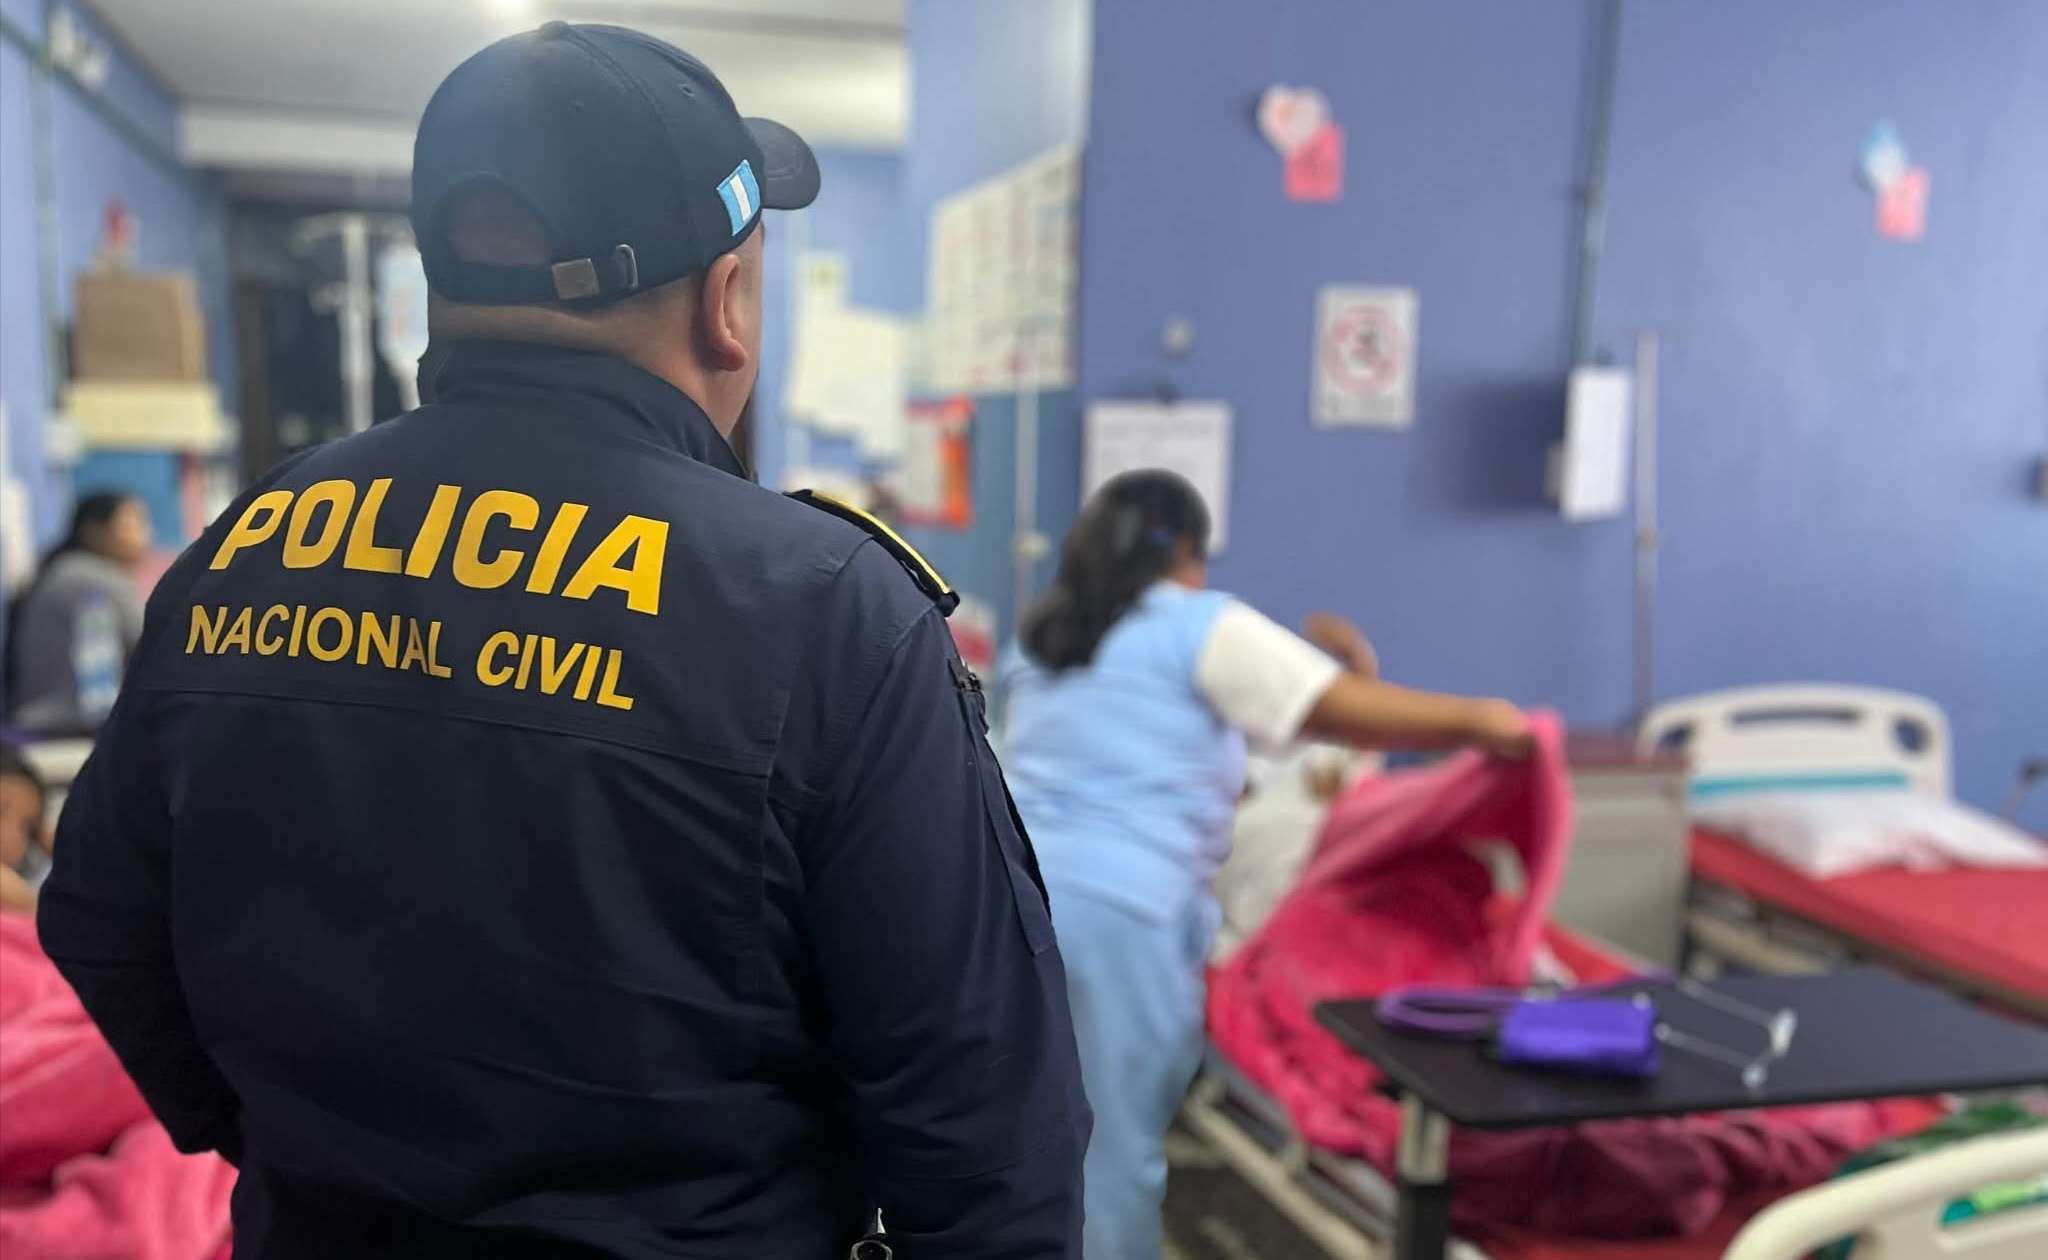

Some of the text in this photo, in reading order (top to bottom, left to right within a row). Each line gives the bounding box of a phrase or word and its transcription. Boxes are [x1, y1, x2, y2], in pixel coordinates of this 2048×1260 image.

[209, 478, 669, 615] POLICIA
[185, 604, 634, 710] NACIONAL CIVIL
